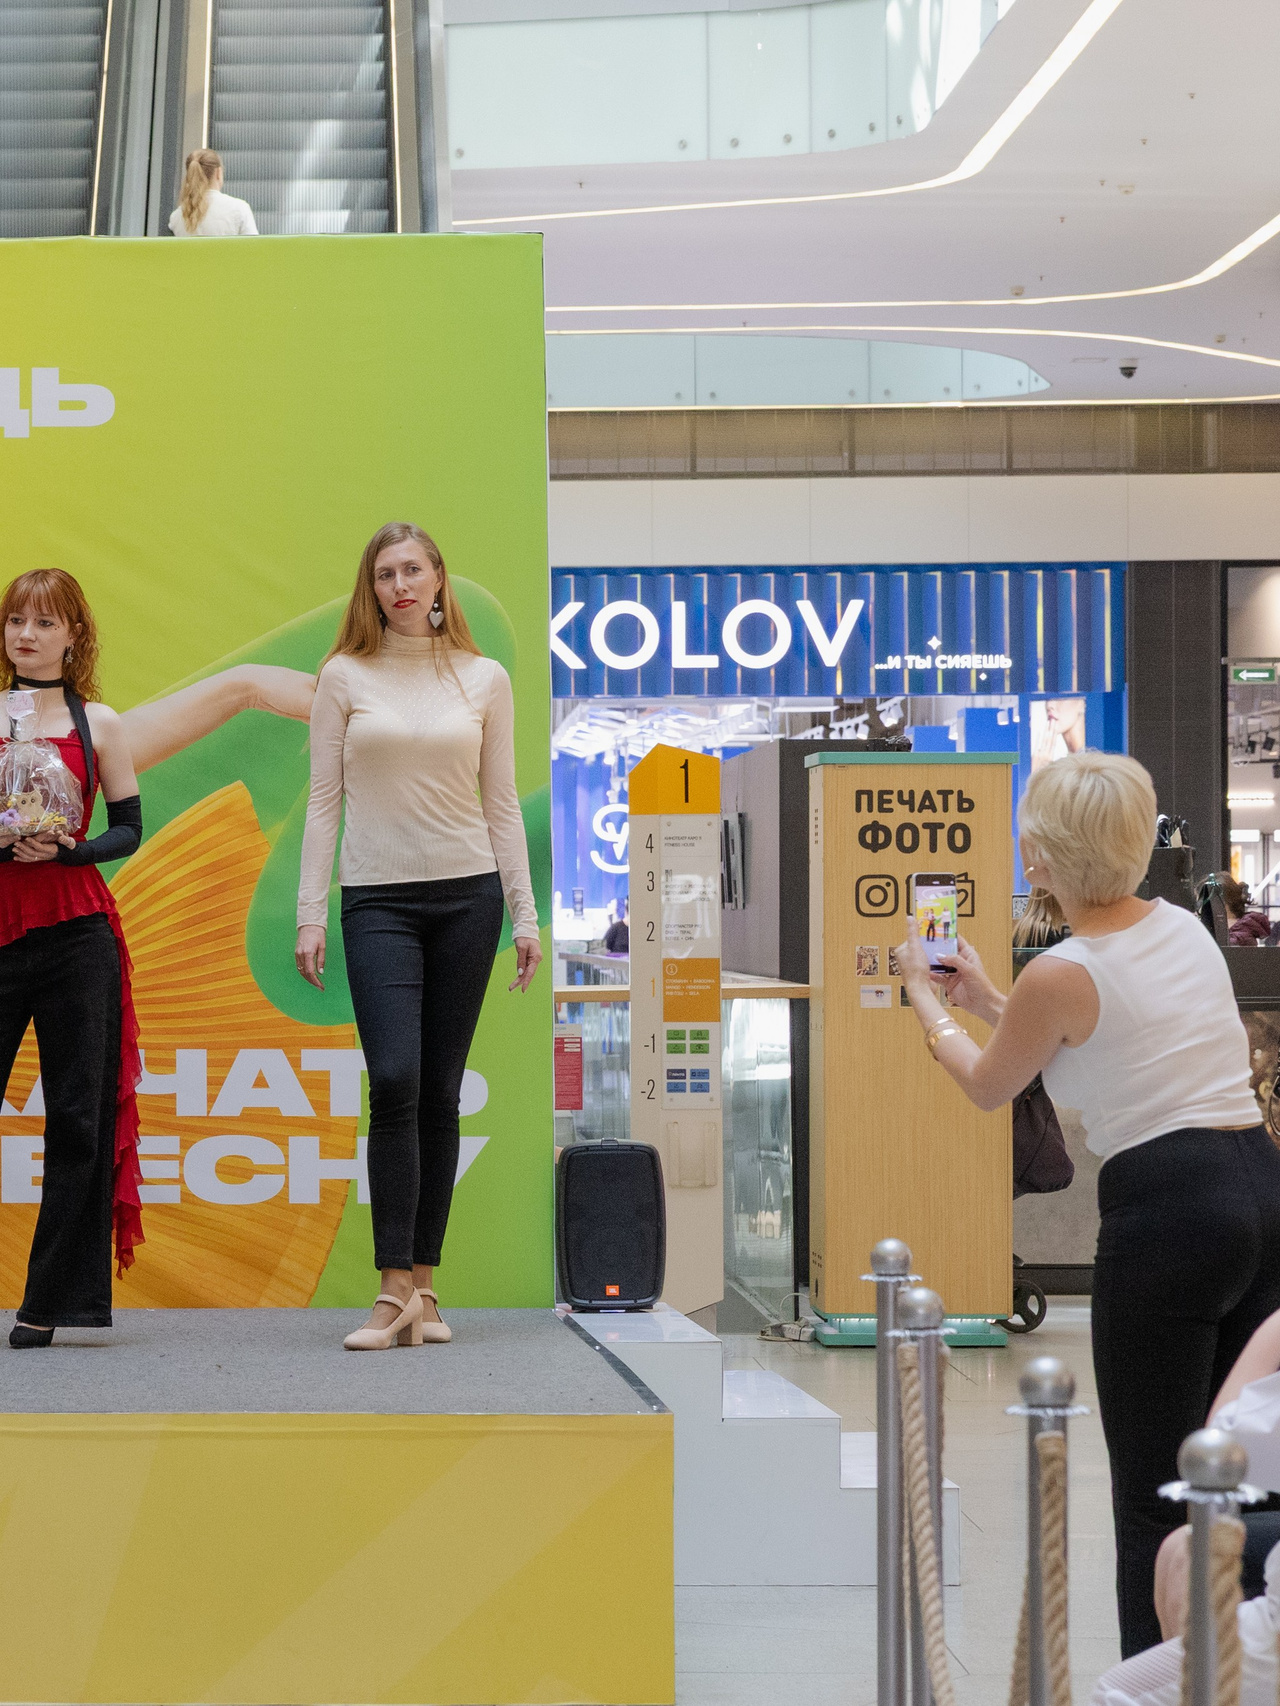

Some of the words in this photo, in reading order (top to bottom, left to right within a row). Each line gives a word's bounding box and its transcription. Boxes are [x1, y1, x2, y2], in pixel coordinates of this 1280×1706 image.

[550, 599, 865, 670] KOLOV
[904, 655, 932, 669] ТЫ
[935, 654, 1013, 669] СИЯЕШЬ
[679, 758, 690, 804] 1
[855, 789, 975, 813] ПЕЧАТЬ
[646, 833, 654, 853] 4
[858, 820, 971, 854] ФОТО
[647, 871, 655, 891] 3
[646, 921, 655, 941] 2
[651, 977, 656, 998] 1
[644, 1033, 655, 1053] -1
[641, 1079, 655, 1099] -2
